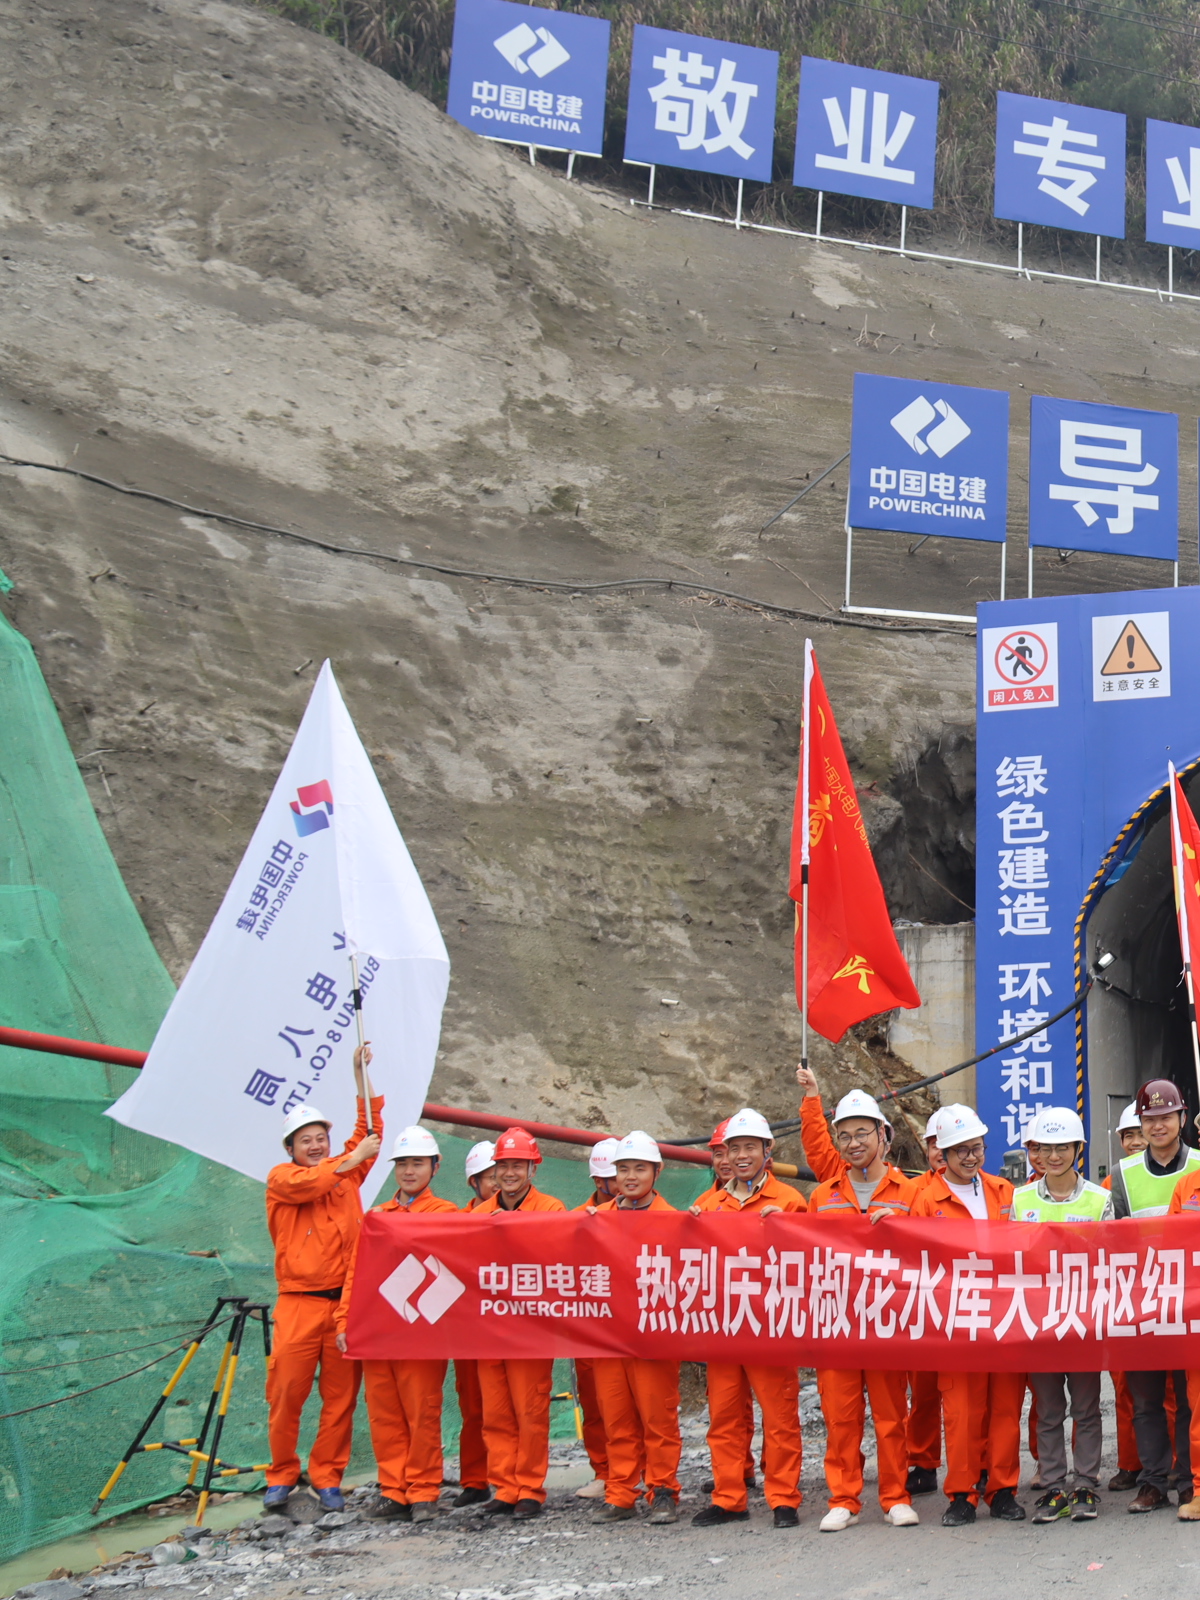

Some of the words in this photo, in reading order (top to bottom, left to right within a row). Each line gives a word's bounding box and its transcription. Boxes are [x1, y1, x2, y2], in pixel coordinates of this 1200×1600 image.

[471, 80, 584, 120] 中国电建
[470, 105, 581, 134] POWERCHINA
[869, 466, 987, 504] 中国电建
[869, 496, 986, 521] POWERCHINA
[993, 688, 1050, 703] 闲人免入
[1102, 677, 1159, 692] 注意安全
[995, 754, 1052, 937] 绿色建造
[478, 1261, 612, 1298] 中国电建
[480, 1299, 613, 1319] POWERCHINA
